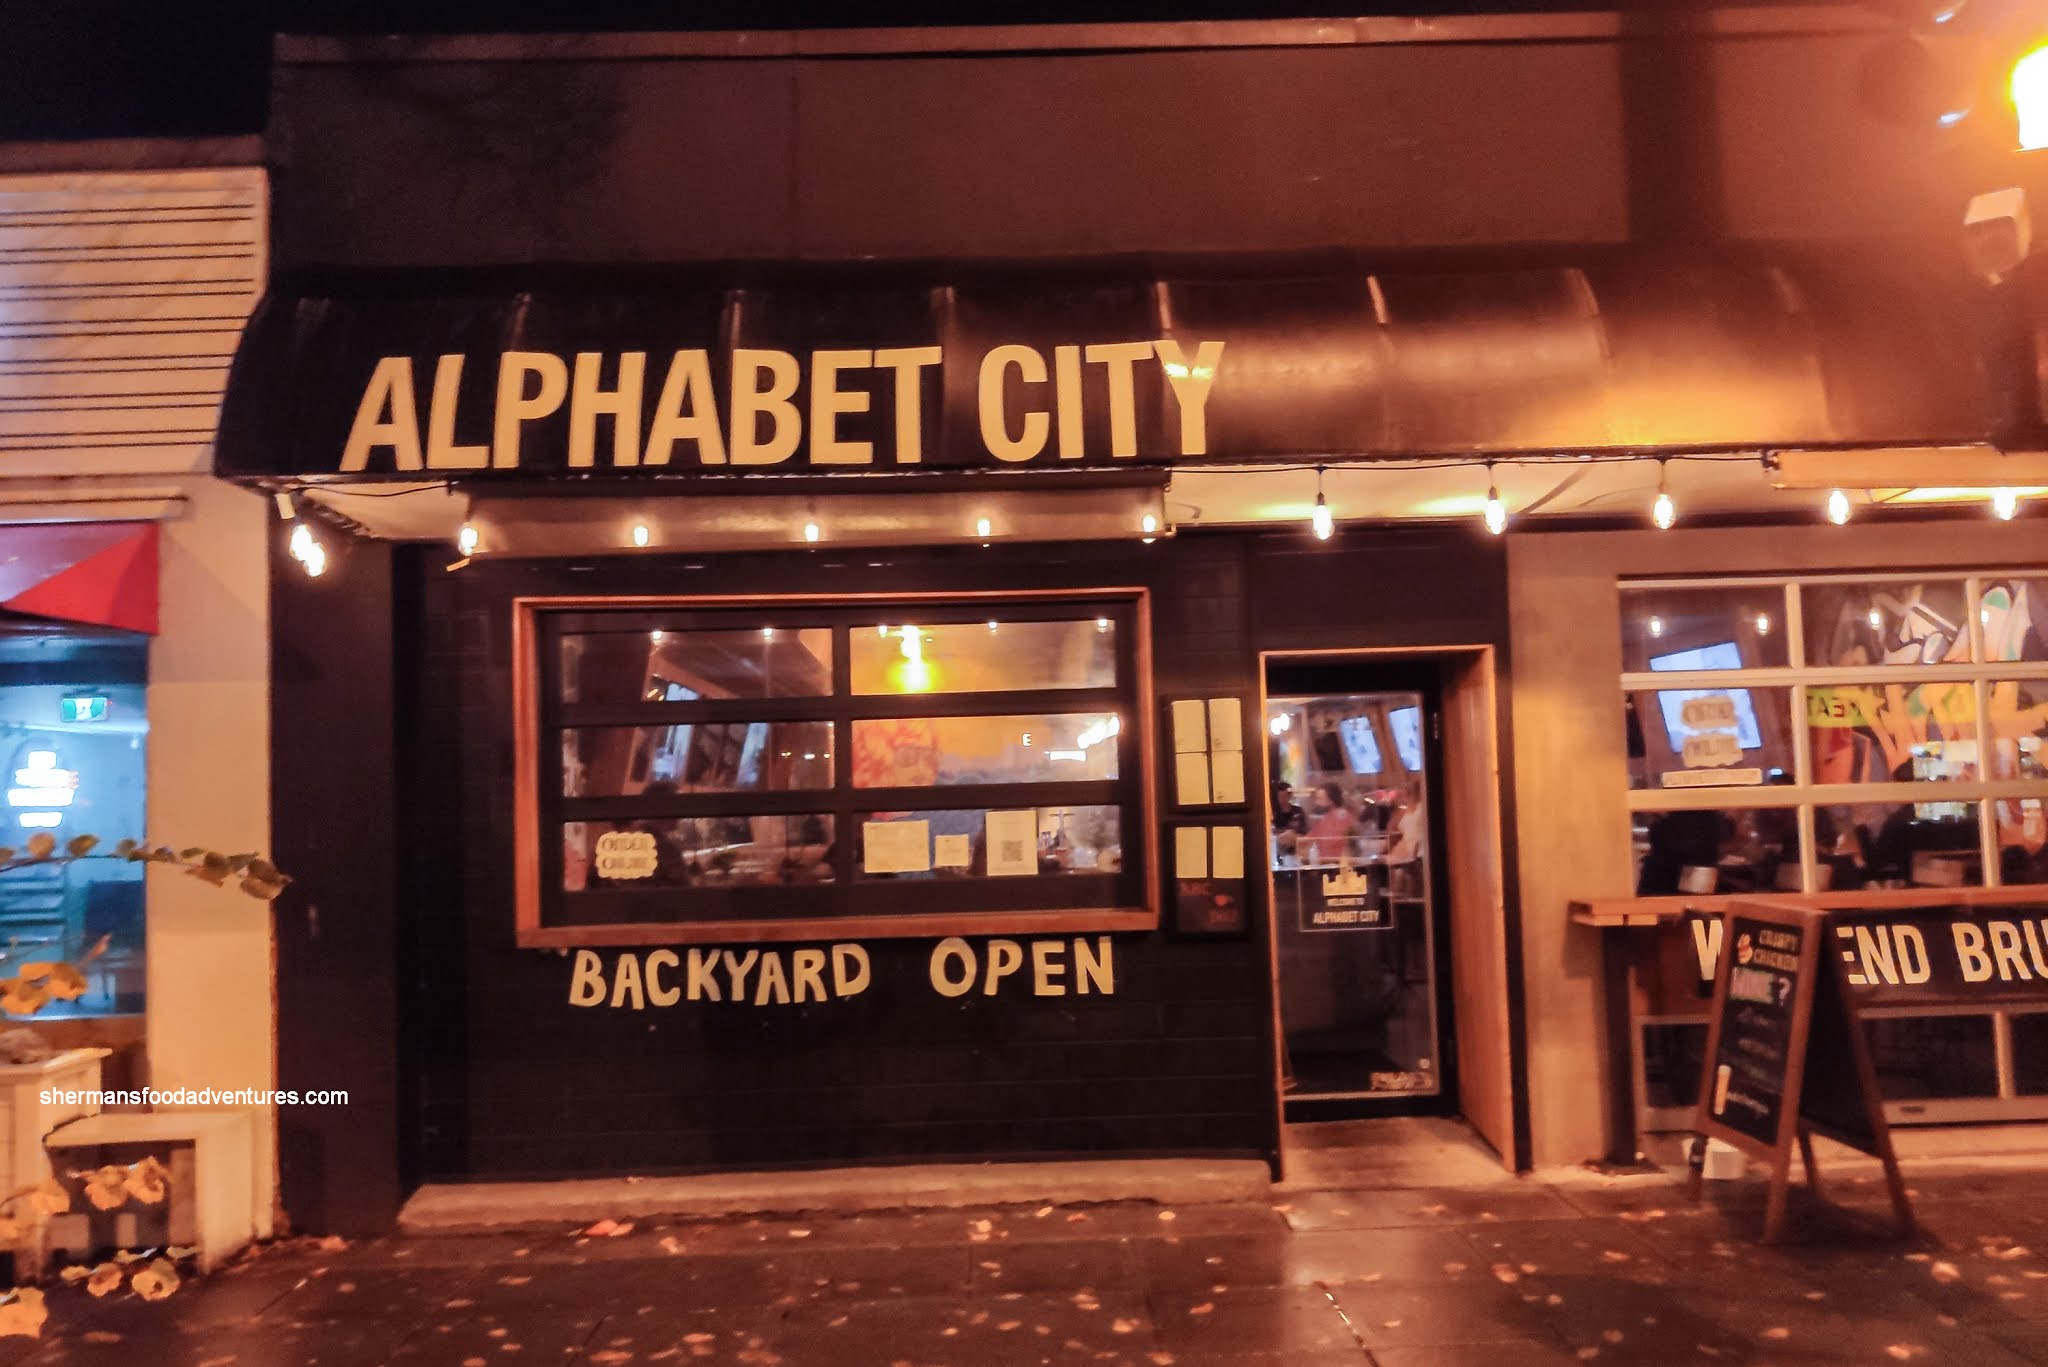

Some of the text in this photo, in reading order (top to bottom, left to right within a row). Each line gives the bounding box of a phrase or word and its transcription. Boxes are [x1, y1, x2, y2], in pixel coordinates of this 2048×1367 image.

[339, 341, 1225, 472] ALPHABET CITY
[568, 936, 1114, 1010] BACKYARD OPEN
